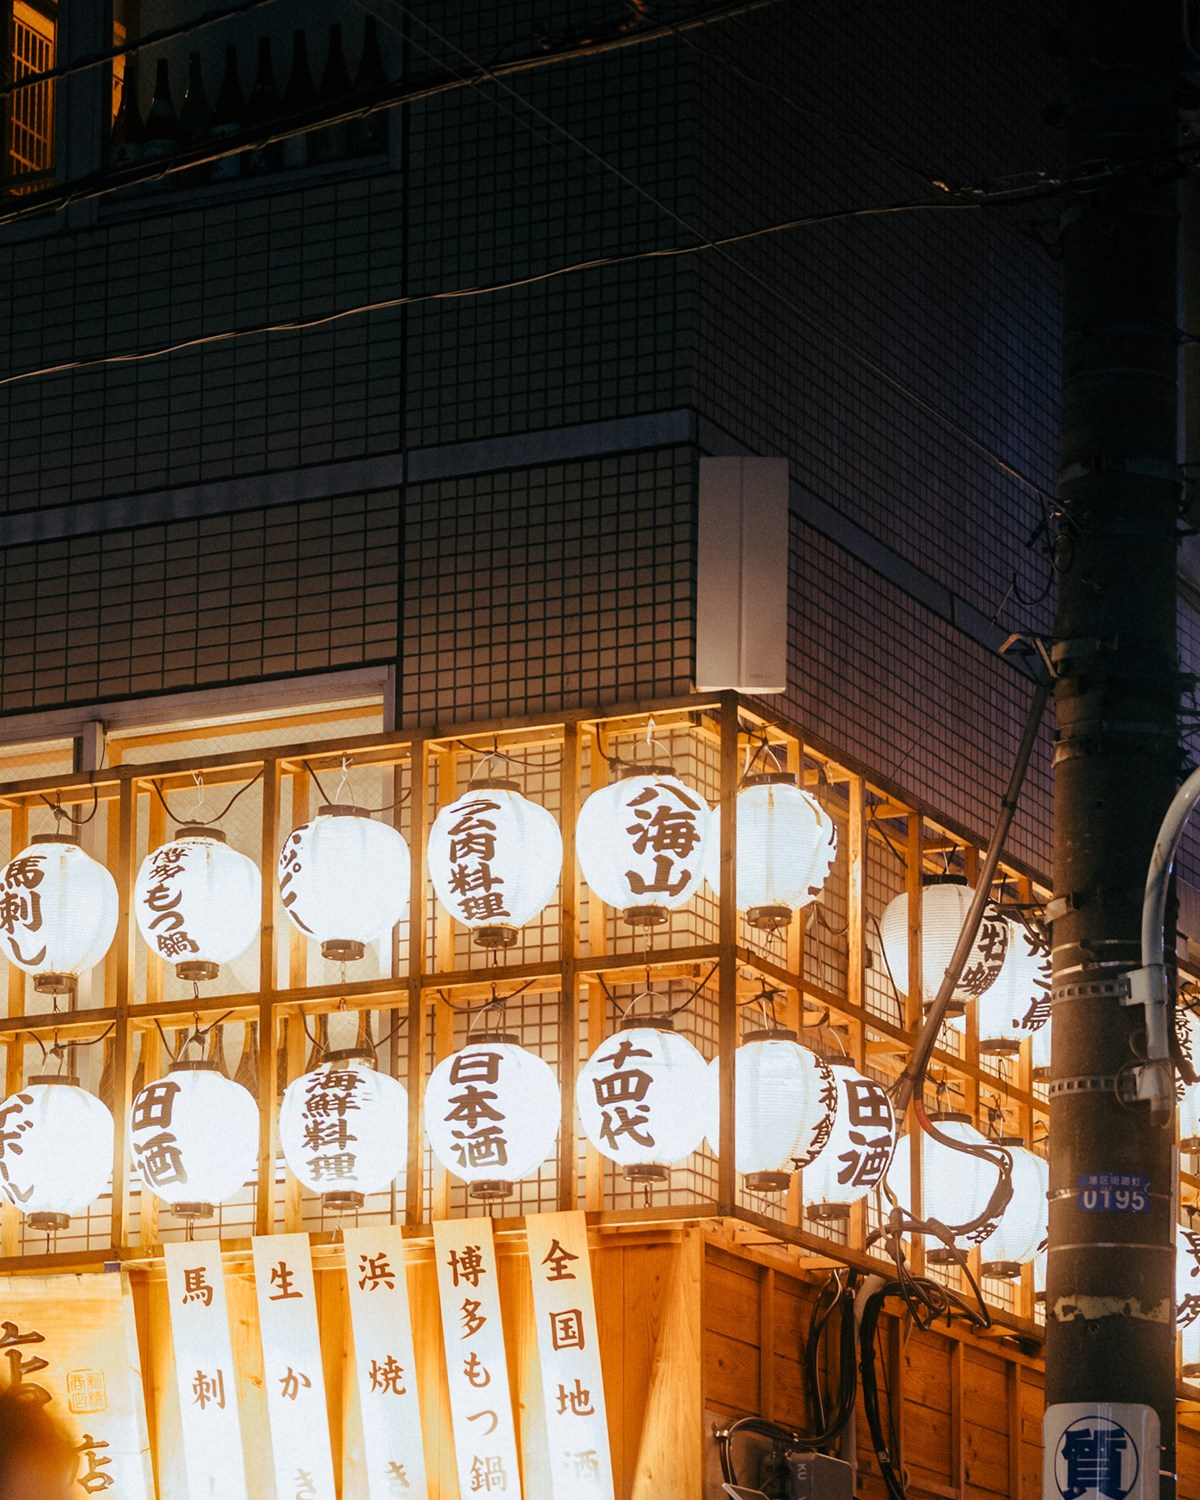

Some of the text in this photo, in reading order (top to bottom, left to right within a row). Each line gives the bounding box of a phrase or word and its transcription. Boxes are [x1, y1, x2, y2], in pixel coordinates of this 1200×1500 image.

[625, 782, 700, 898] 八海山
[0, 855, 48, 966] 馬刺し
[143, 845, 200, 957] 博多もつ鍋
[131, 1081, 188, 1187] 田酒
[301, 1069, 367, 1183] 海鮮料理
[443, 1051, 510, 1169] 日本酒
[592, 1041, 656, 1151] 十四代
[837, 1079, 893, 1187] 田酒
[357, 1250, 411, 1499] 浜焼き
[448, 1244, 508, 1495] 博多もつ鍋
[541, 1238, 601, 1485] 全国地酒
